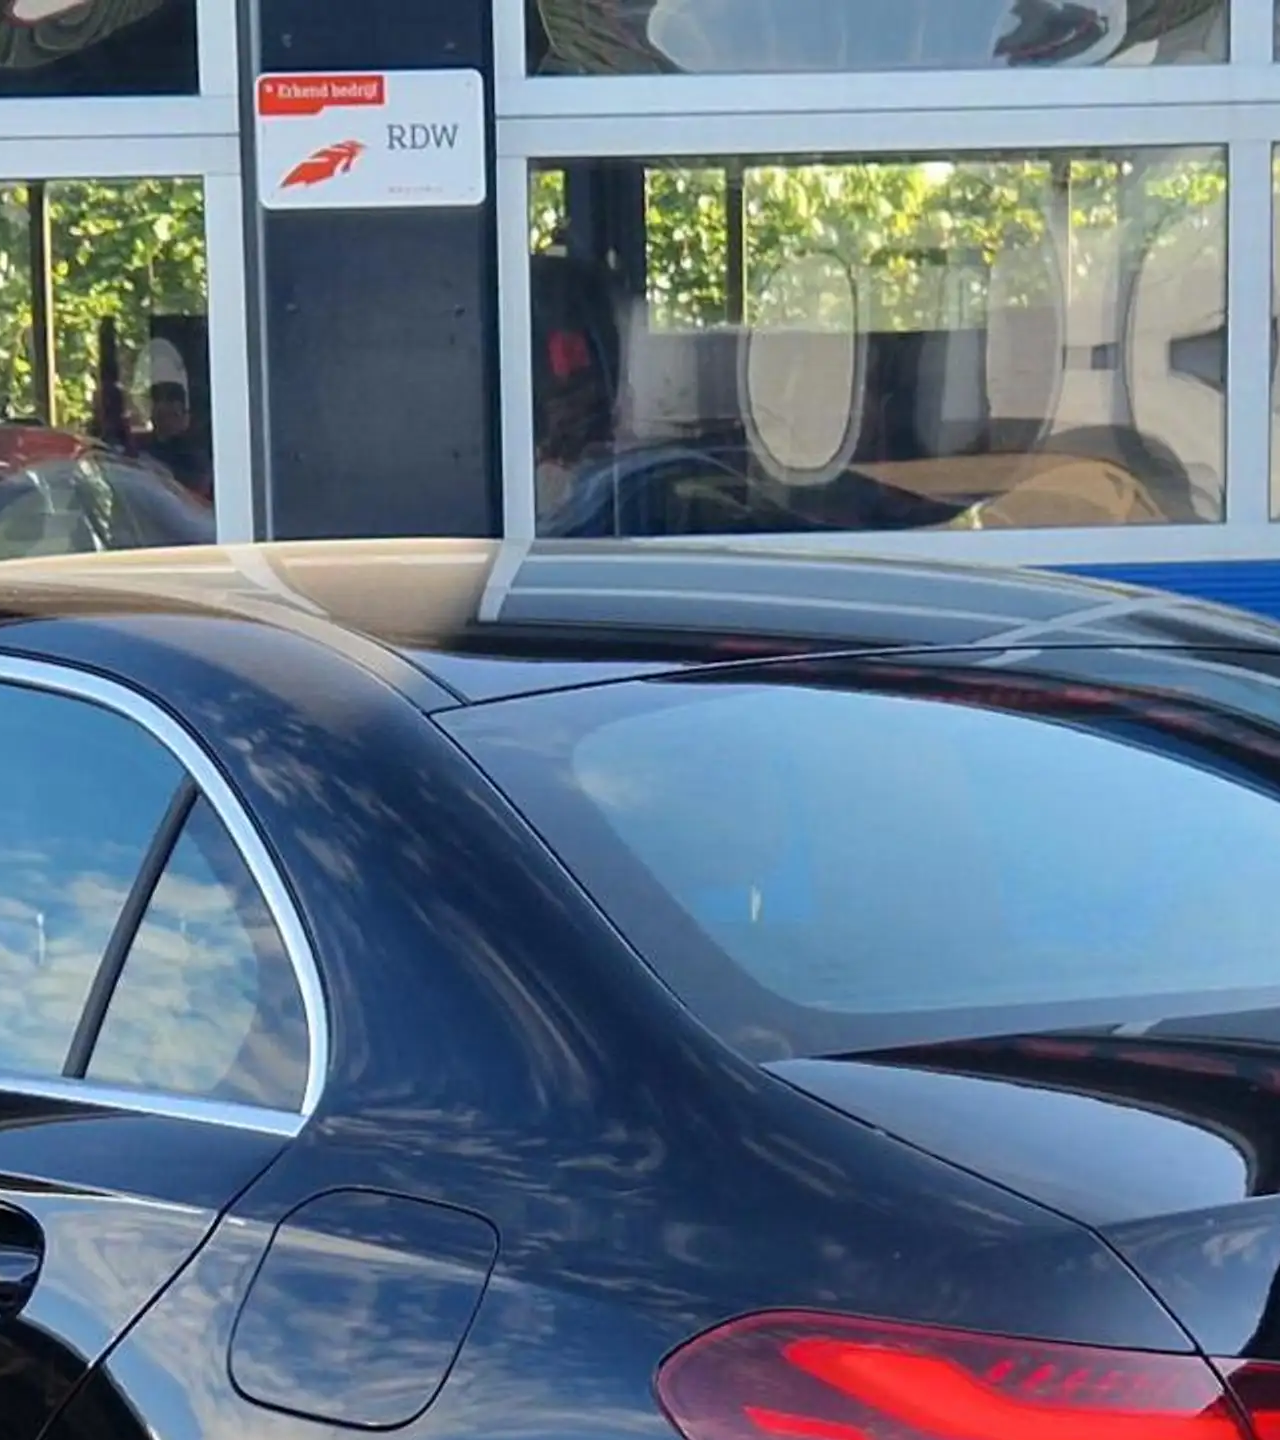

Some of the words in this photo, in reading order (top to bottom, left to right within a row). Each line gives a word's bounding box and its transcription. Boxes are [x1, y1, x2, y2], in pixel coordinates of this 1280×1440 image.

[277, 83, 329, 99] Erkend
[331, 81, 378, 100] bedrijf
[386, 123, 460, 151] RDW
